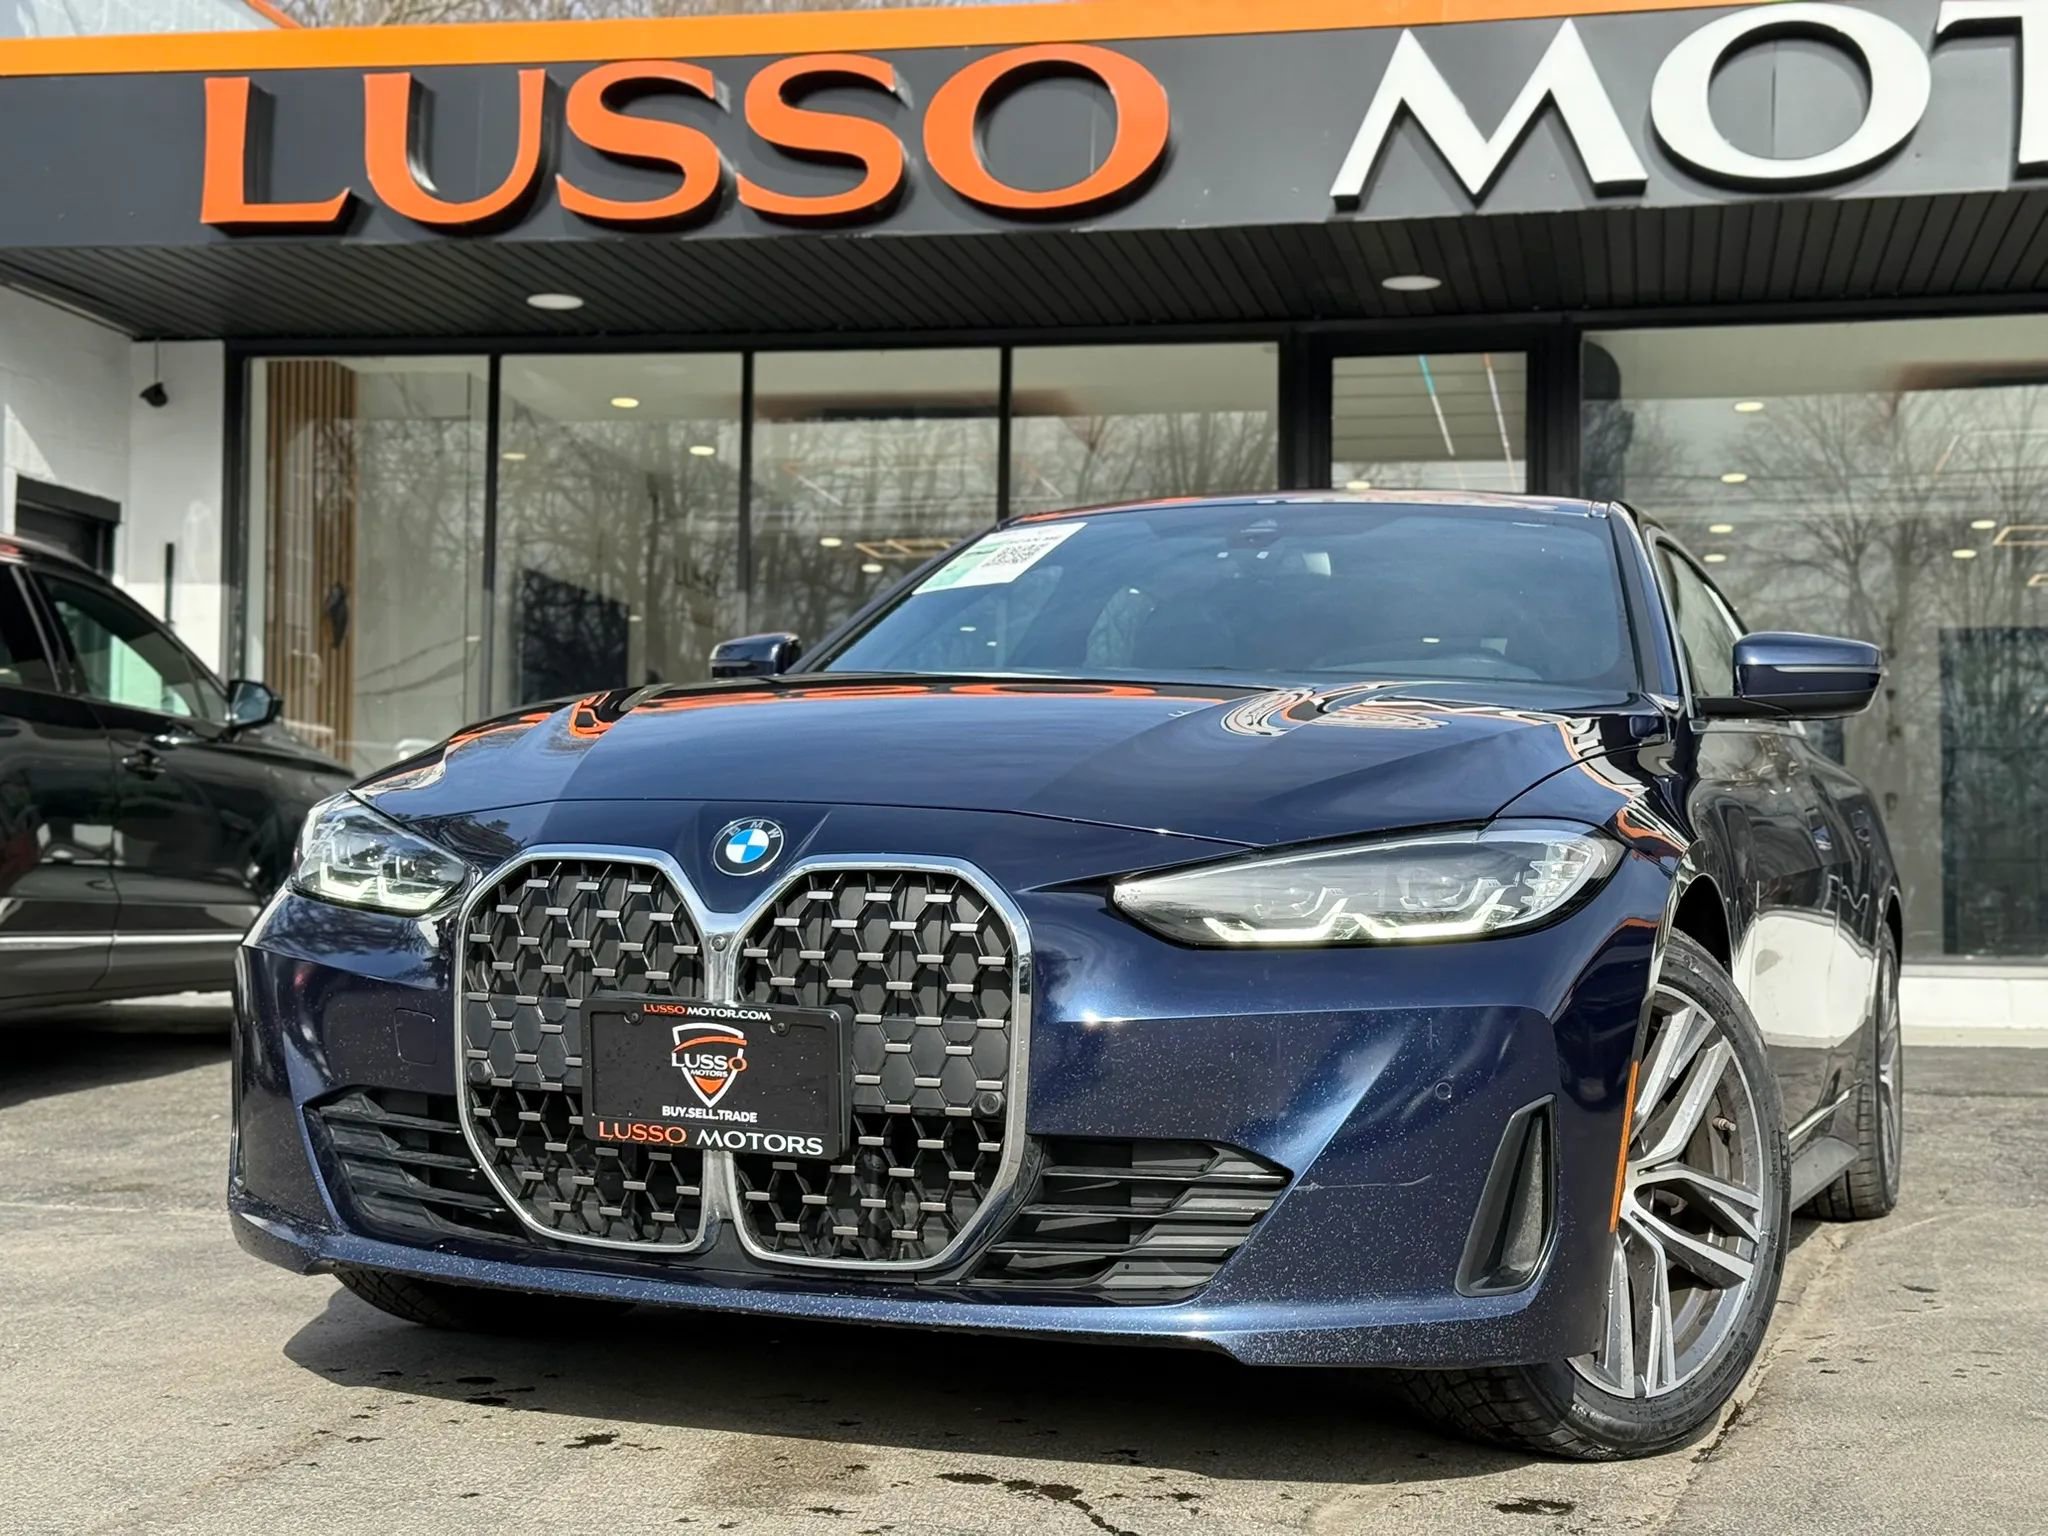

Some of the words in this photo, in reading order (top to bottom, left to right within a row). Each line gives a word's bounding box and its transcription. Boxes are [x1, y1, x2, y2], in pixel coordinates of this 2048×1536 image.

[200, 43, 1171, 225] LUSSO
[727, 820, 781, 840] BMW
[671, 1052, 748, 1072] LUSSO
[690, 1069, 729, 1078] MOTORS
[661, 1105, 759, 1123] BUY.SELL.TRADE
[598, 1121, 687, 1145] LUSSO
[696, 1130, 824, 1156] MOTORS
